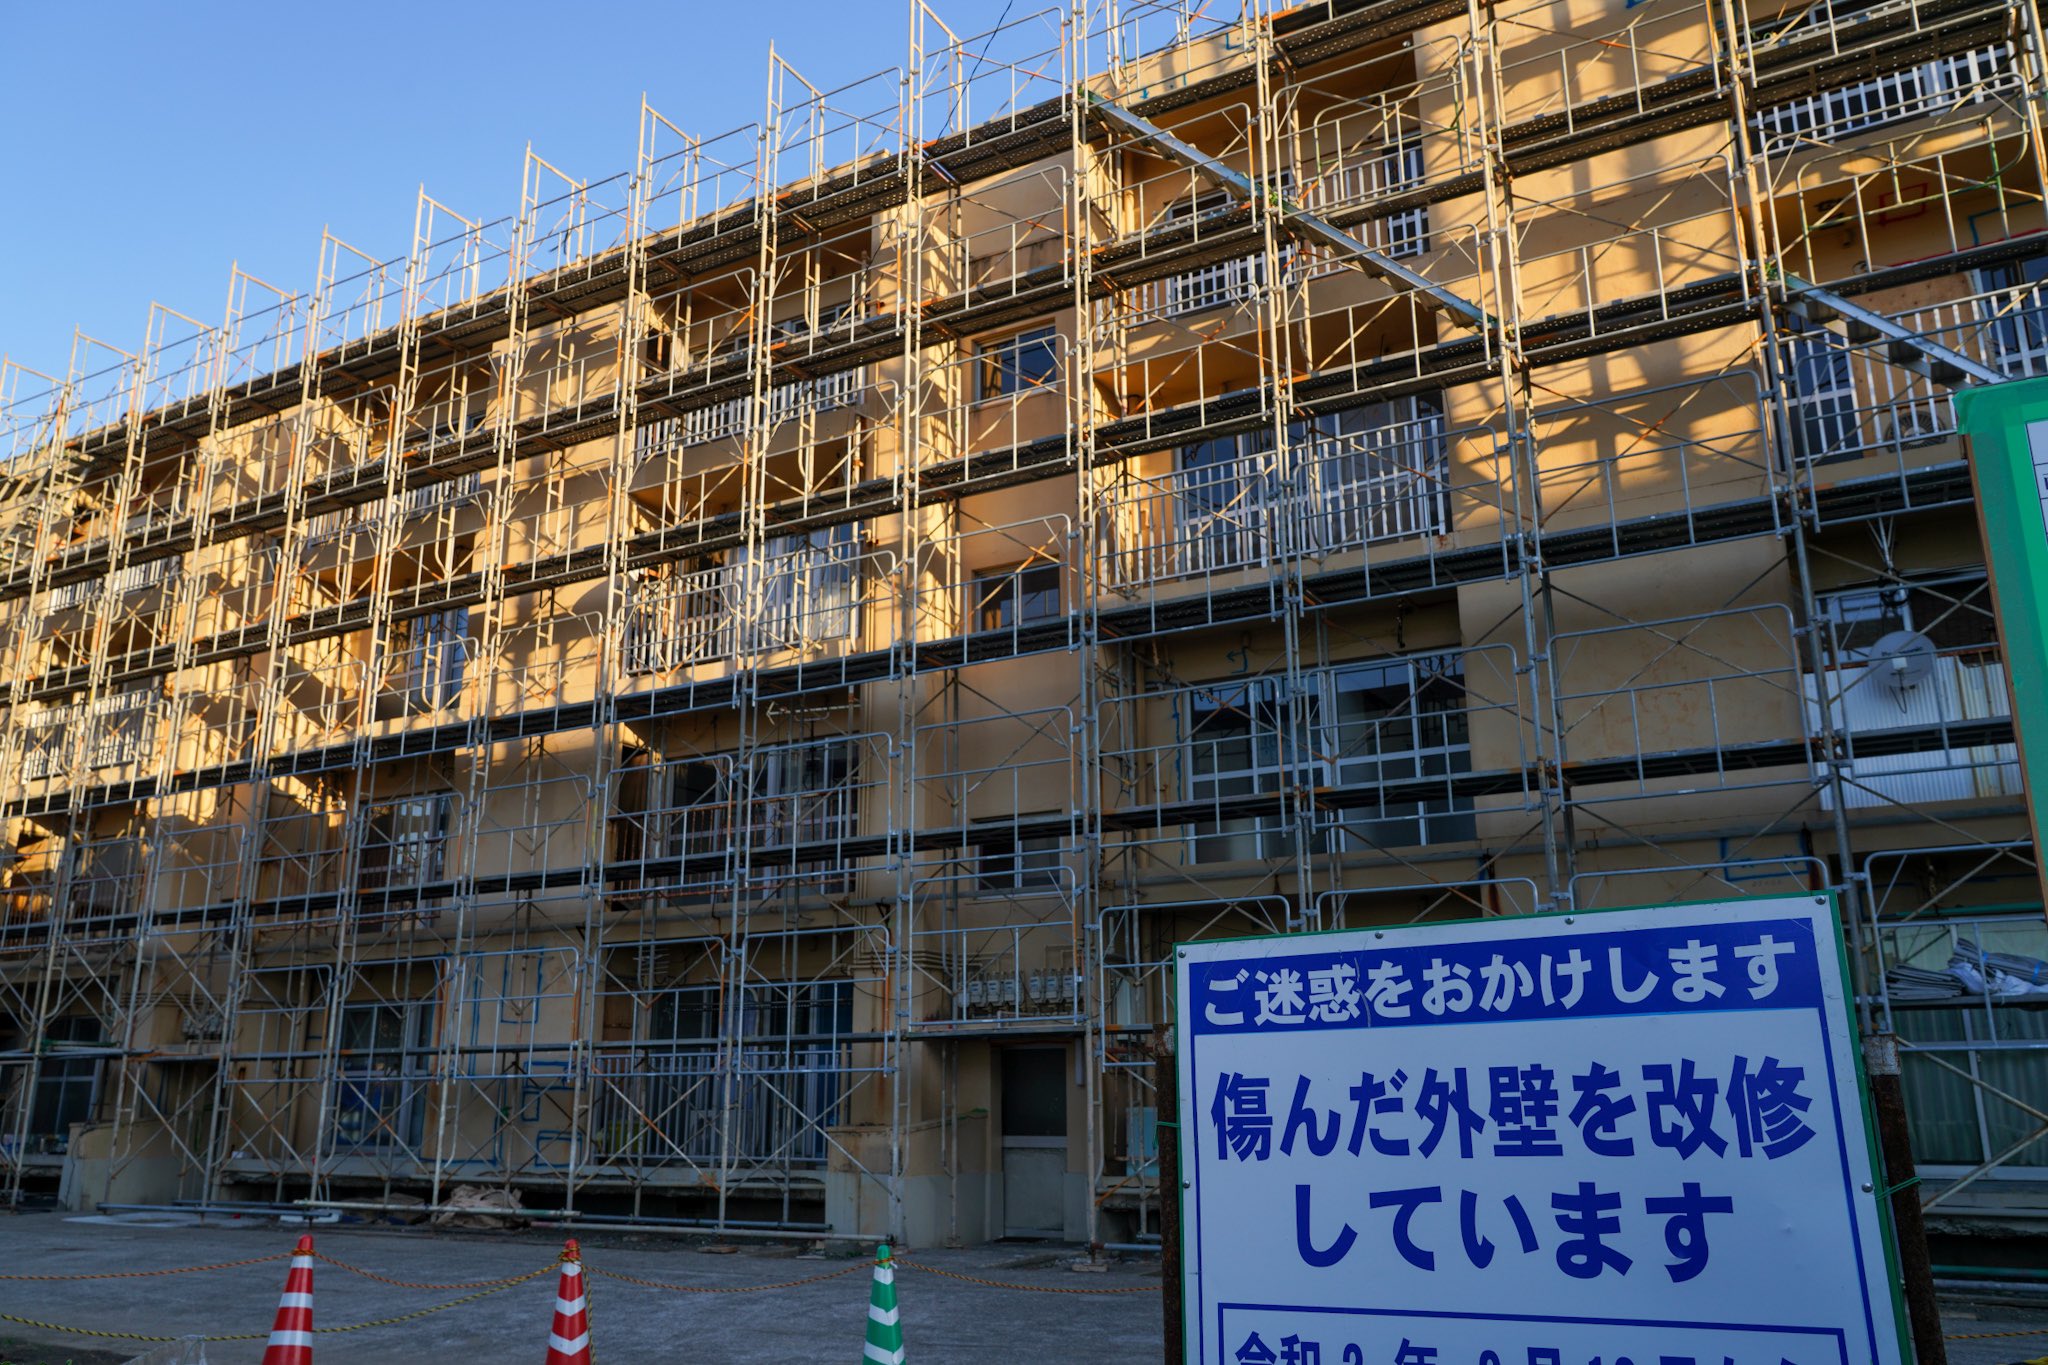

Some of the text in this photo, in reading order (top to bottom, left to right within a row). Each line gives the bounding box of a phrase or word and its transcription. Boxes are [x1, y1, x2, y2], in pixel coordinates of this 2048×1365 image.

[1205, 935, 1796, 1026] ご迷惑をおかけします
[1211, 1055, 1816, 1162] 傷んだ外壁を改修
[1295, 1181, 1735, 1283] しています
